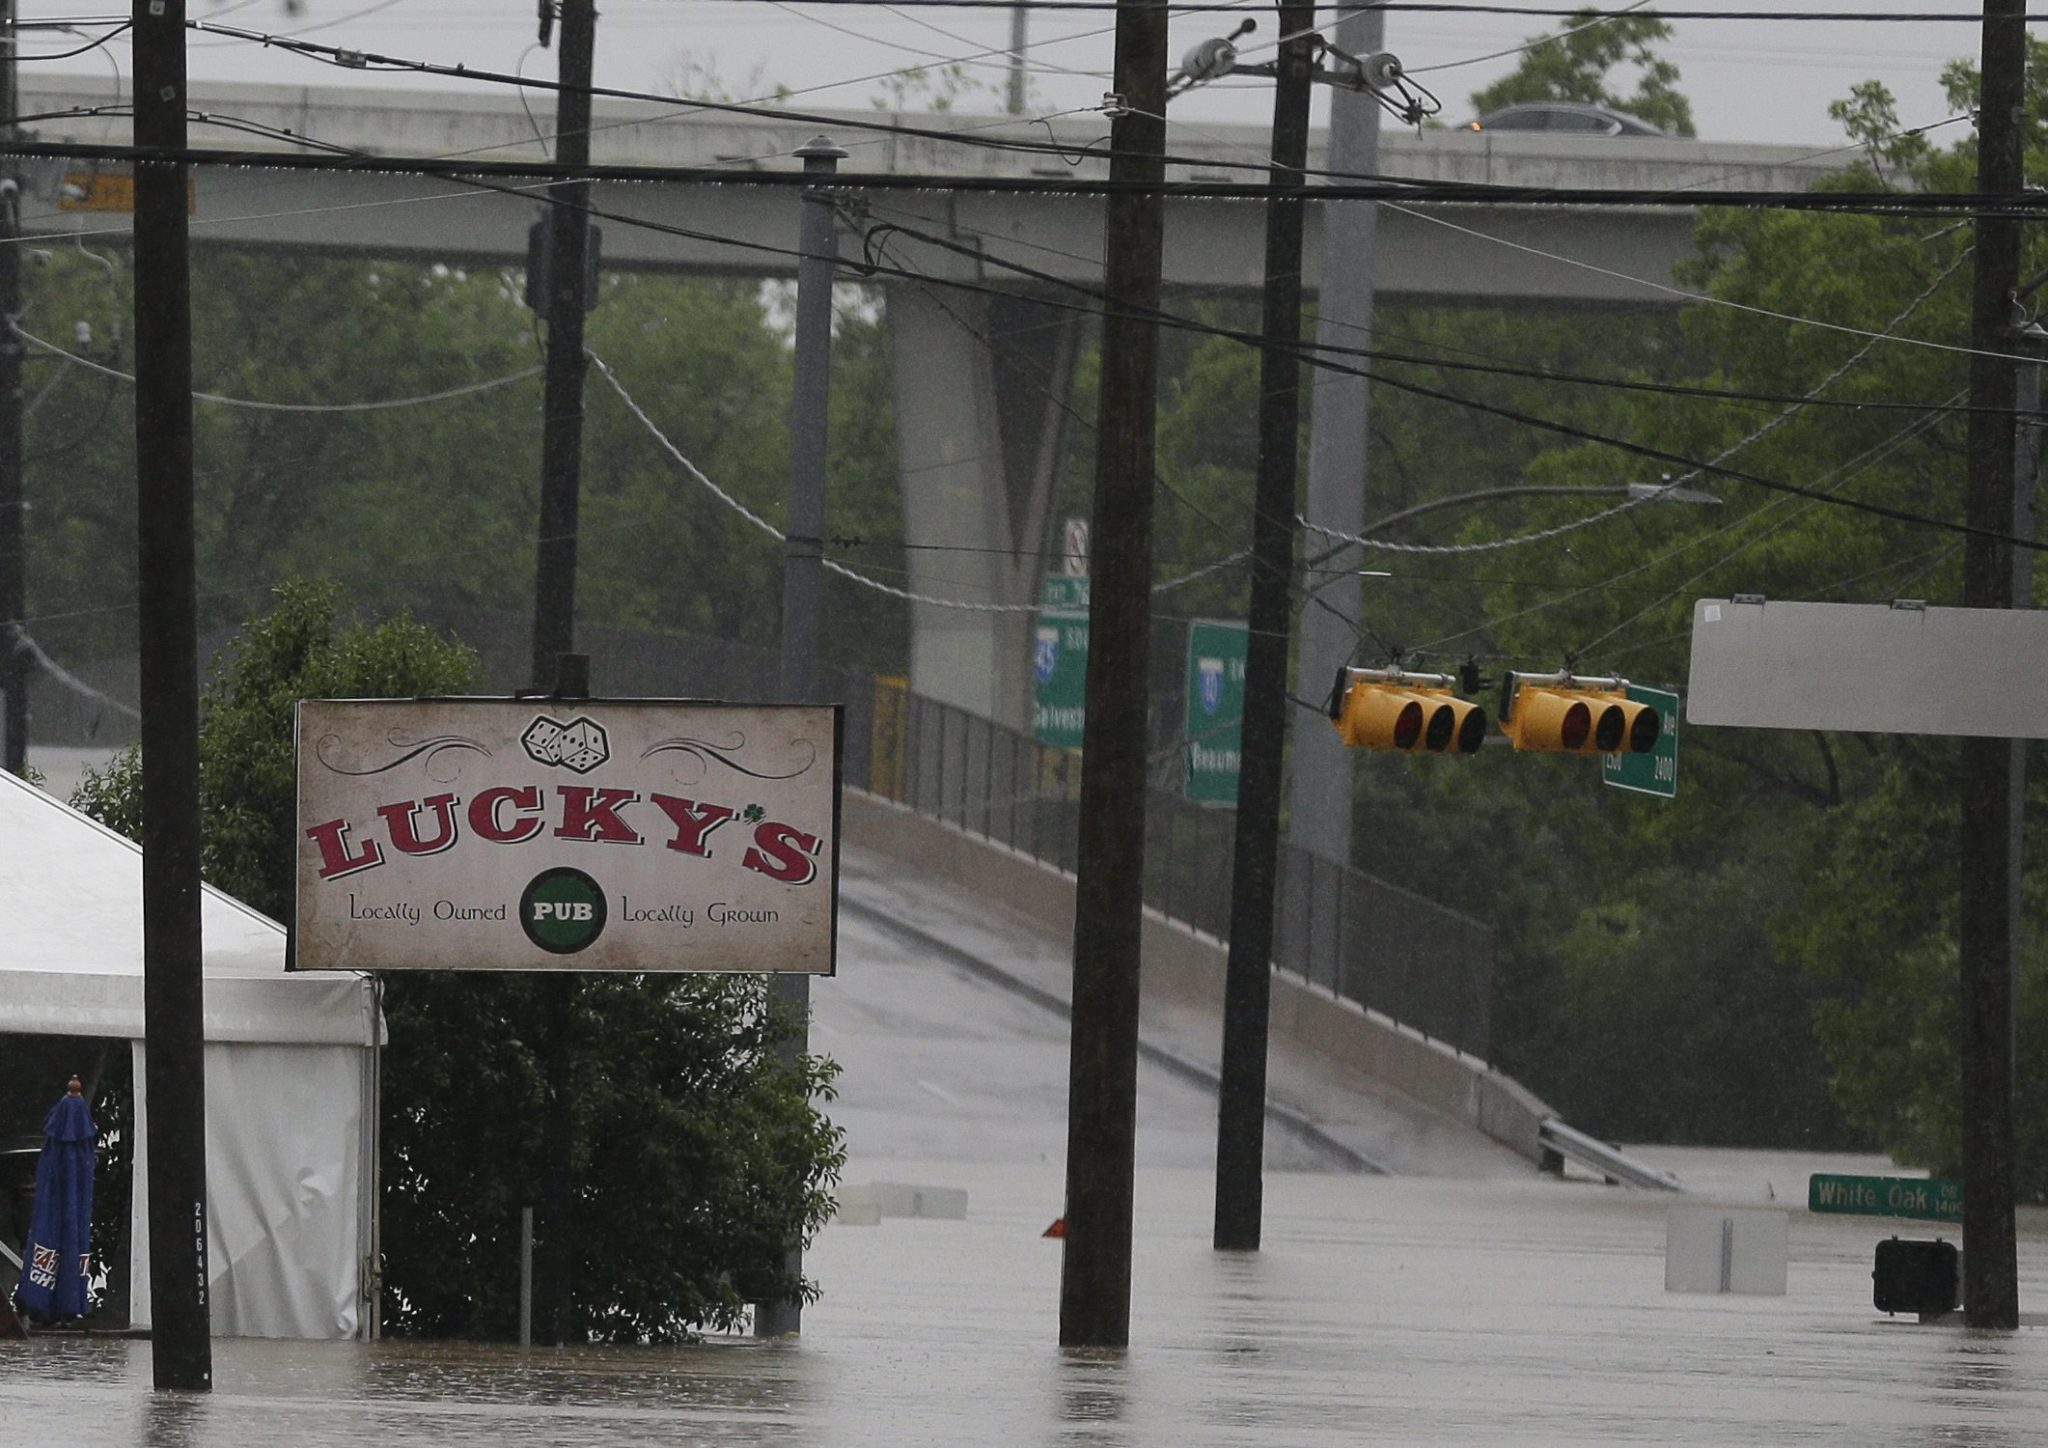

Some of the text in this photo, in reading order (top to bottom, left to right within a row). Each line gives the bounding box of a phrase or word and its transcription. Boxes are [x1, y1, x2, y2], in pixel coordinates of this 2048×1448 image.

[1655, 756, 1674, 782] 2400
[306, 785, 823, 886] LUCKY'S
[349, 894, 507, 926] Locally Owned
[533, 902, 593, 921] PUB
[622, 896, 779, 929] Locally Grown
[1819, 1182, 1927, 1211] White Oak
[193, 1202, 206, 1306] 206432
